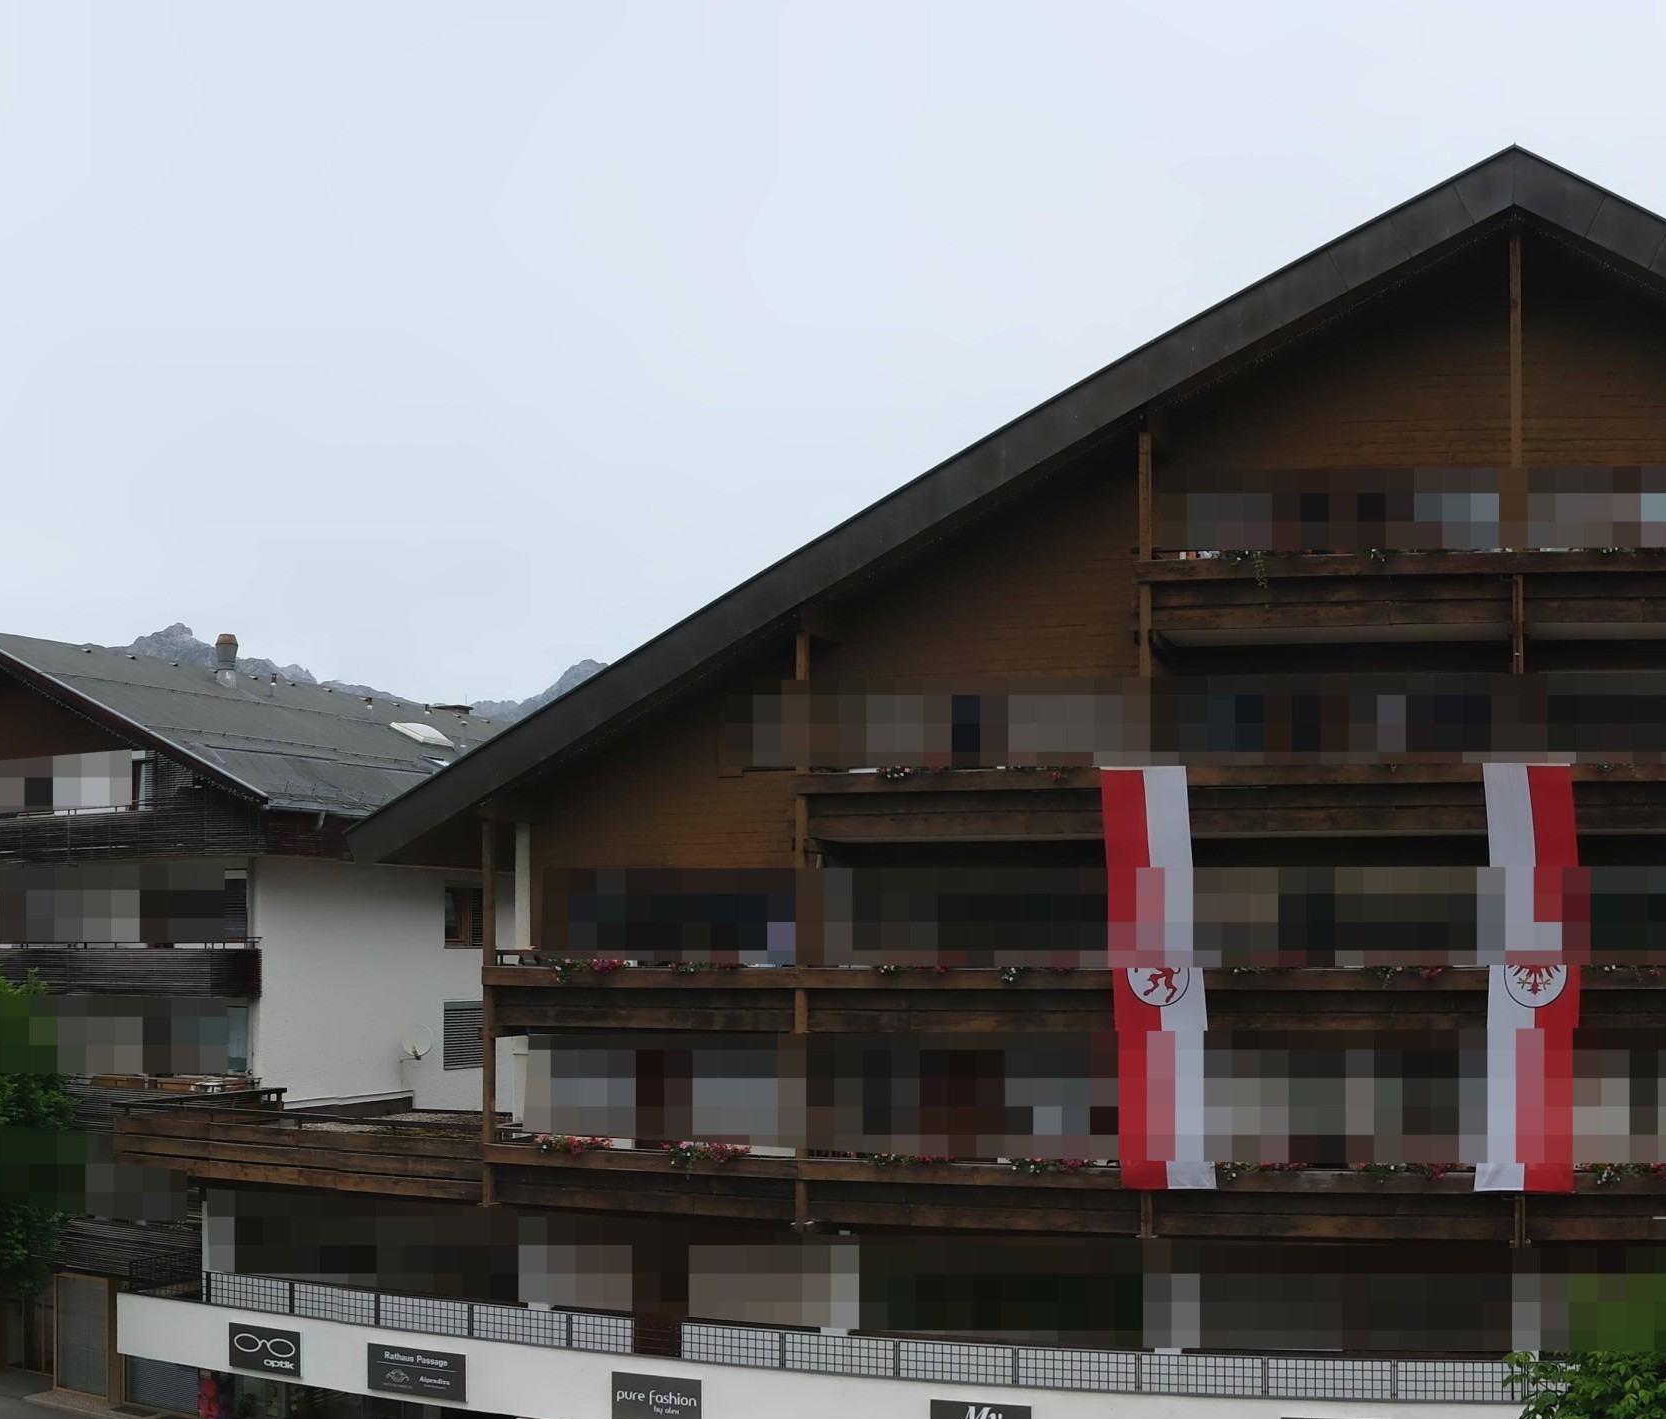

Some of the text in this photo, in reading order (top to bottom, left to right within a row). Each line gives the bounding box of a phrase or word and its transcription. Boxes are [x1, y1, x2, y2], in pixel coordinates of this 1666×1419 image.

[384, 1351, 448, 1368] Rathaus Passage
[616, 1389, 697, 1407] pure fashion
[653, 1405, 680, 1415] by alex
